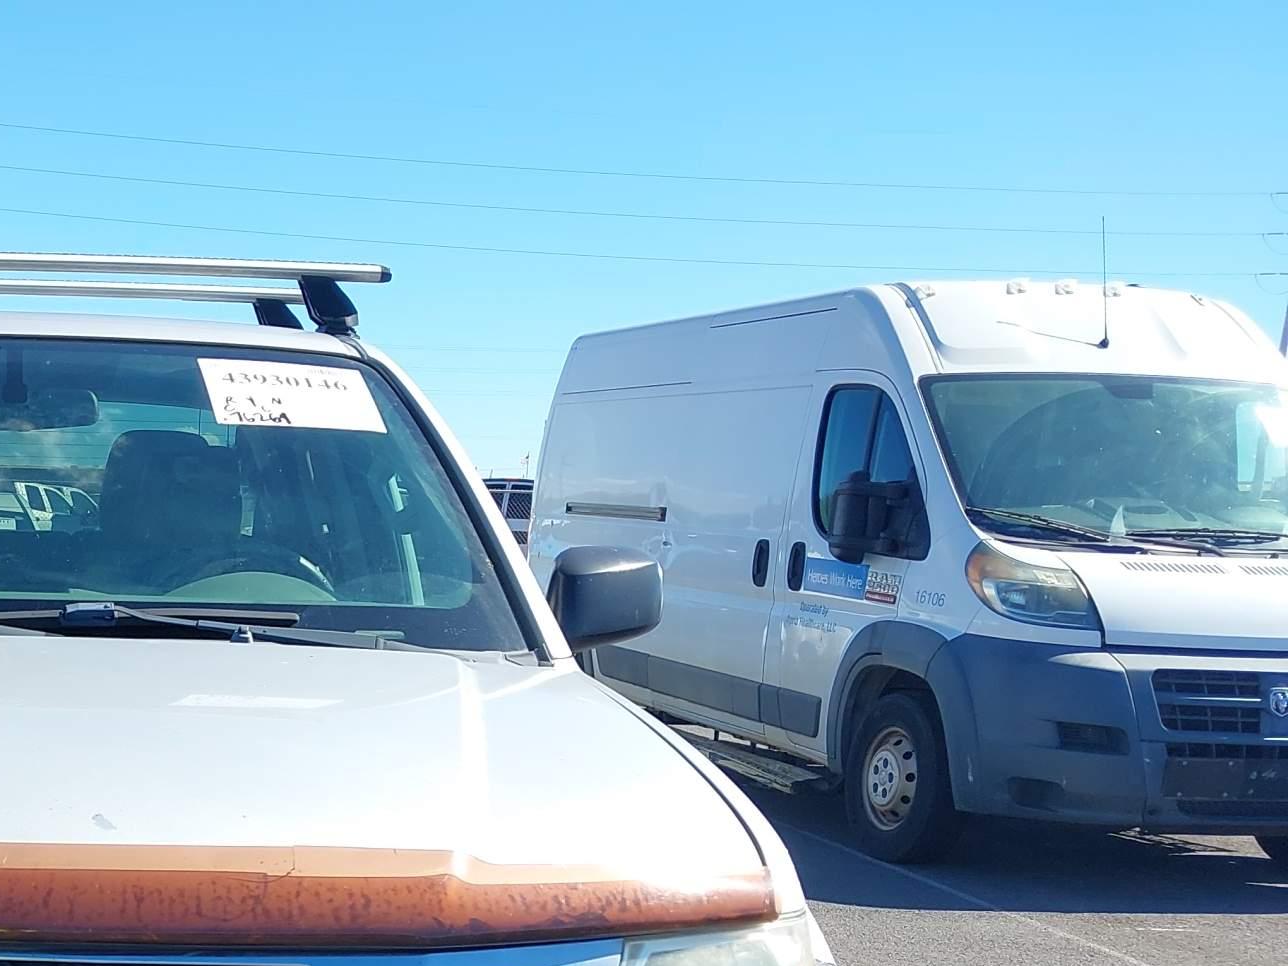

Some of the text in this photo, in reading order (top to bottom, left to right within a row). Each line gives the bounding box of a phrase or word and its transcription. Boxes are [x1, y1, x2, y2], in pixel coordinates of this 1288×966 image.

[222, 373, 348, 390] 43930146
[807, 568, 864, 590] Heroes Work Here
[915, 589, 946, 607] 16106
